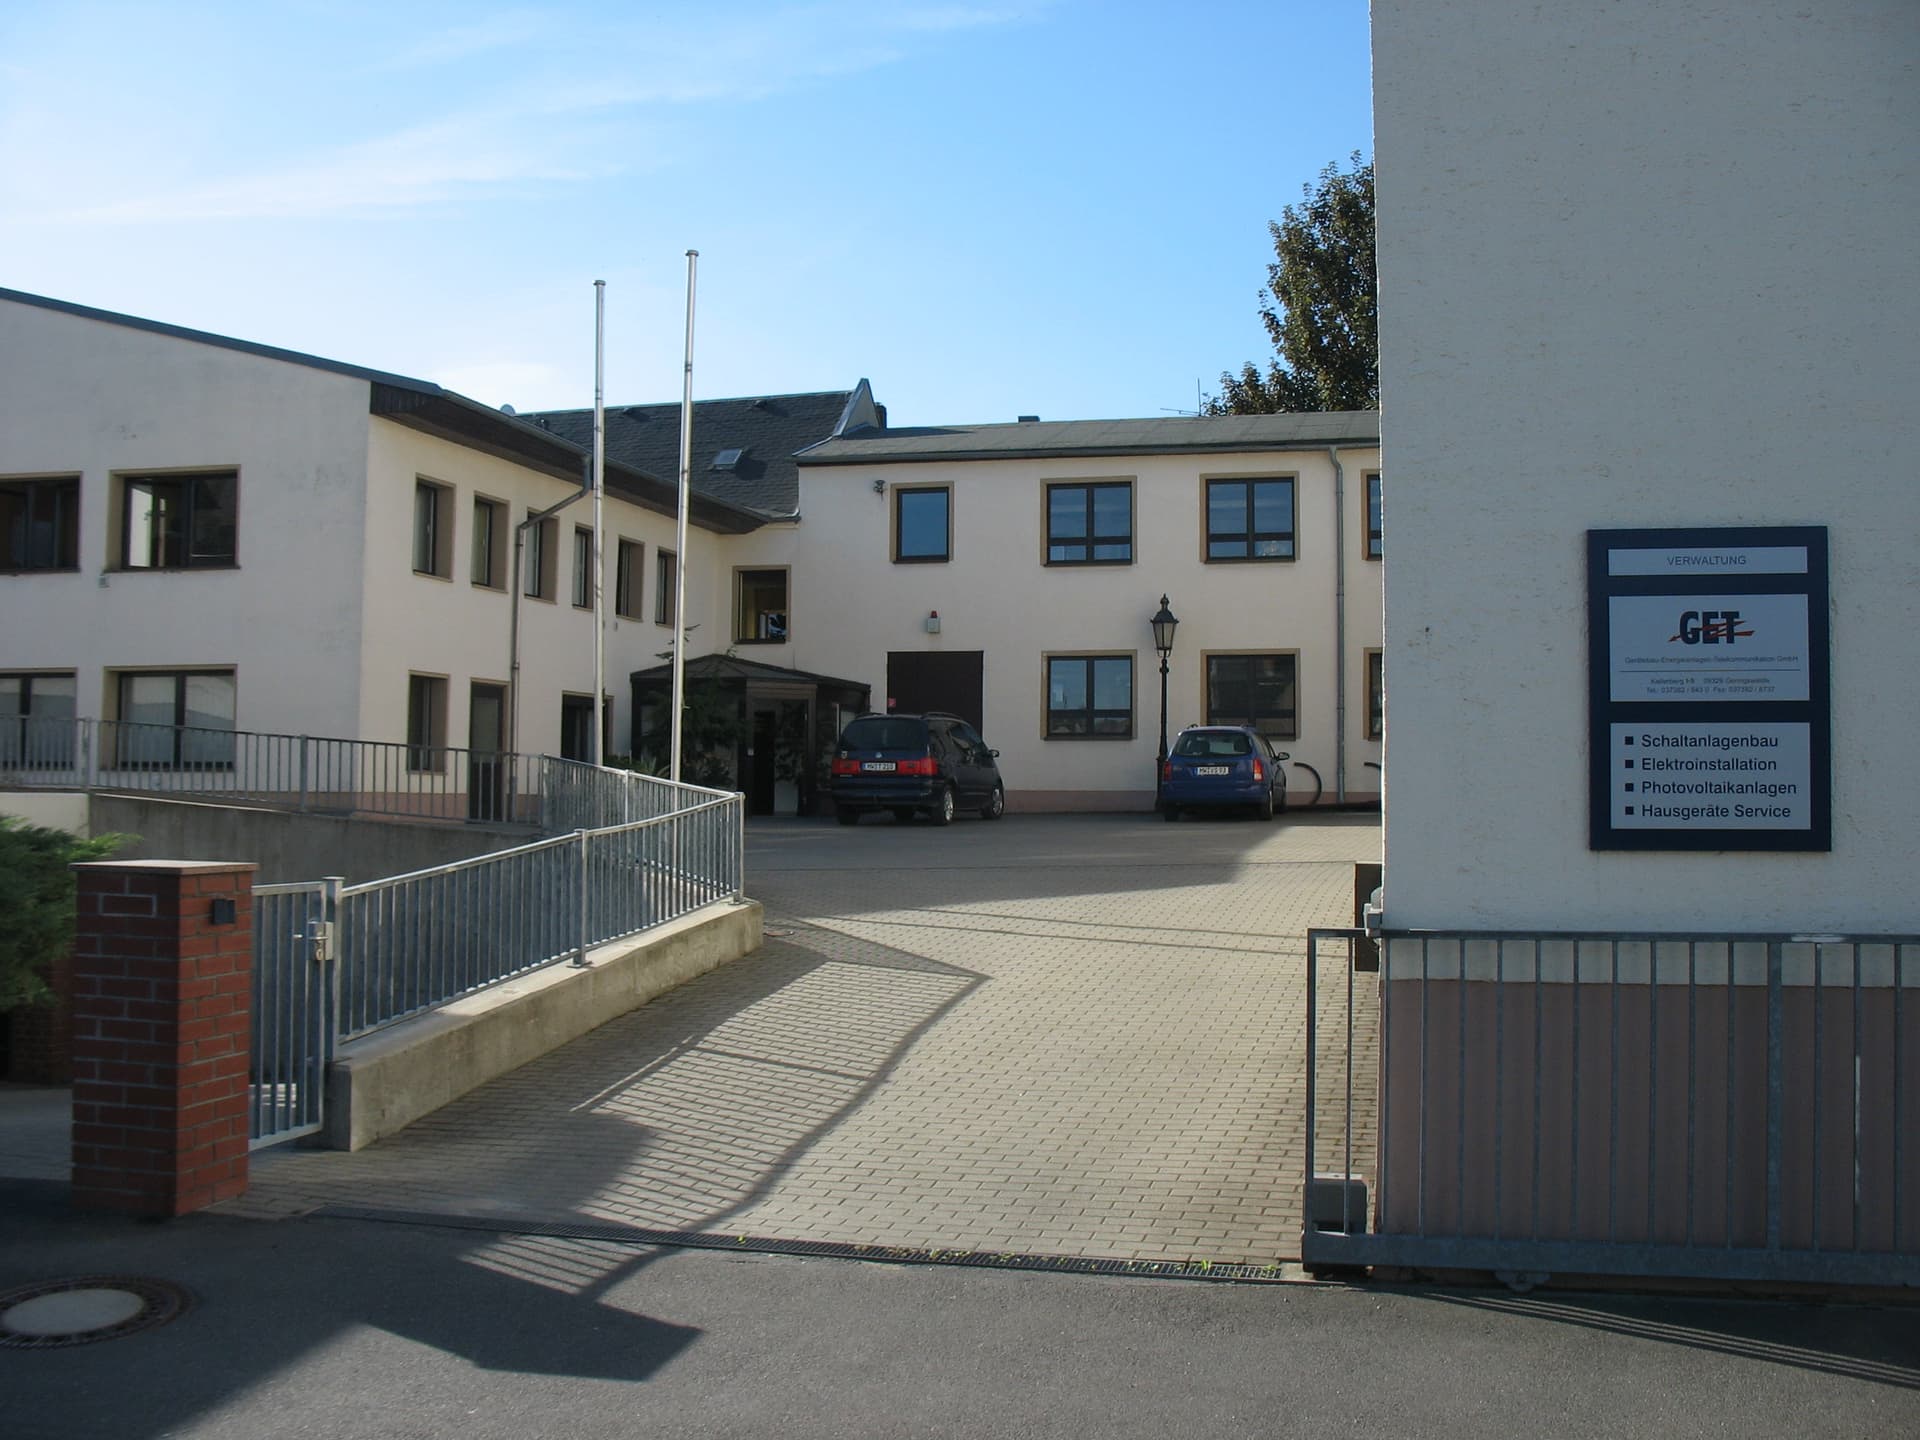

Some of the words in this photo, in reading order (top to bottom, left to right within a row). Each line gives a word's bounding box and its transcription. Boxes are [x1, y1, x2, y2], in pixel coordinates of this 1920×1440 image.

[1667, 555, 1747, 566] VERWALTUNG
[1679, 610, 1740, 645] GET
[1641, 734, 1779, 751] Schaltanlagenbau
[1641, 757, 1777, 771] Elektroinstallation
[1641, 781, 1797, 798] Photovoltaikanlagen
[1641, 804, 1729, 821] Hausgeräte
[1734, 804, 1791, 818] Service
